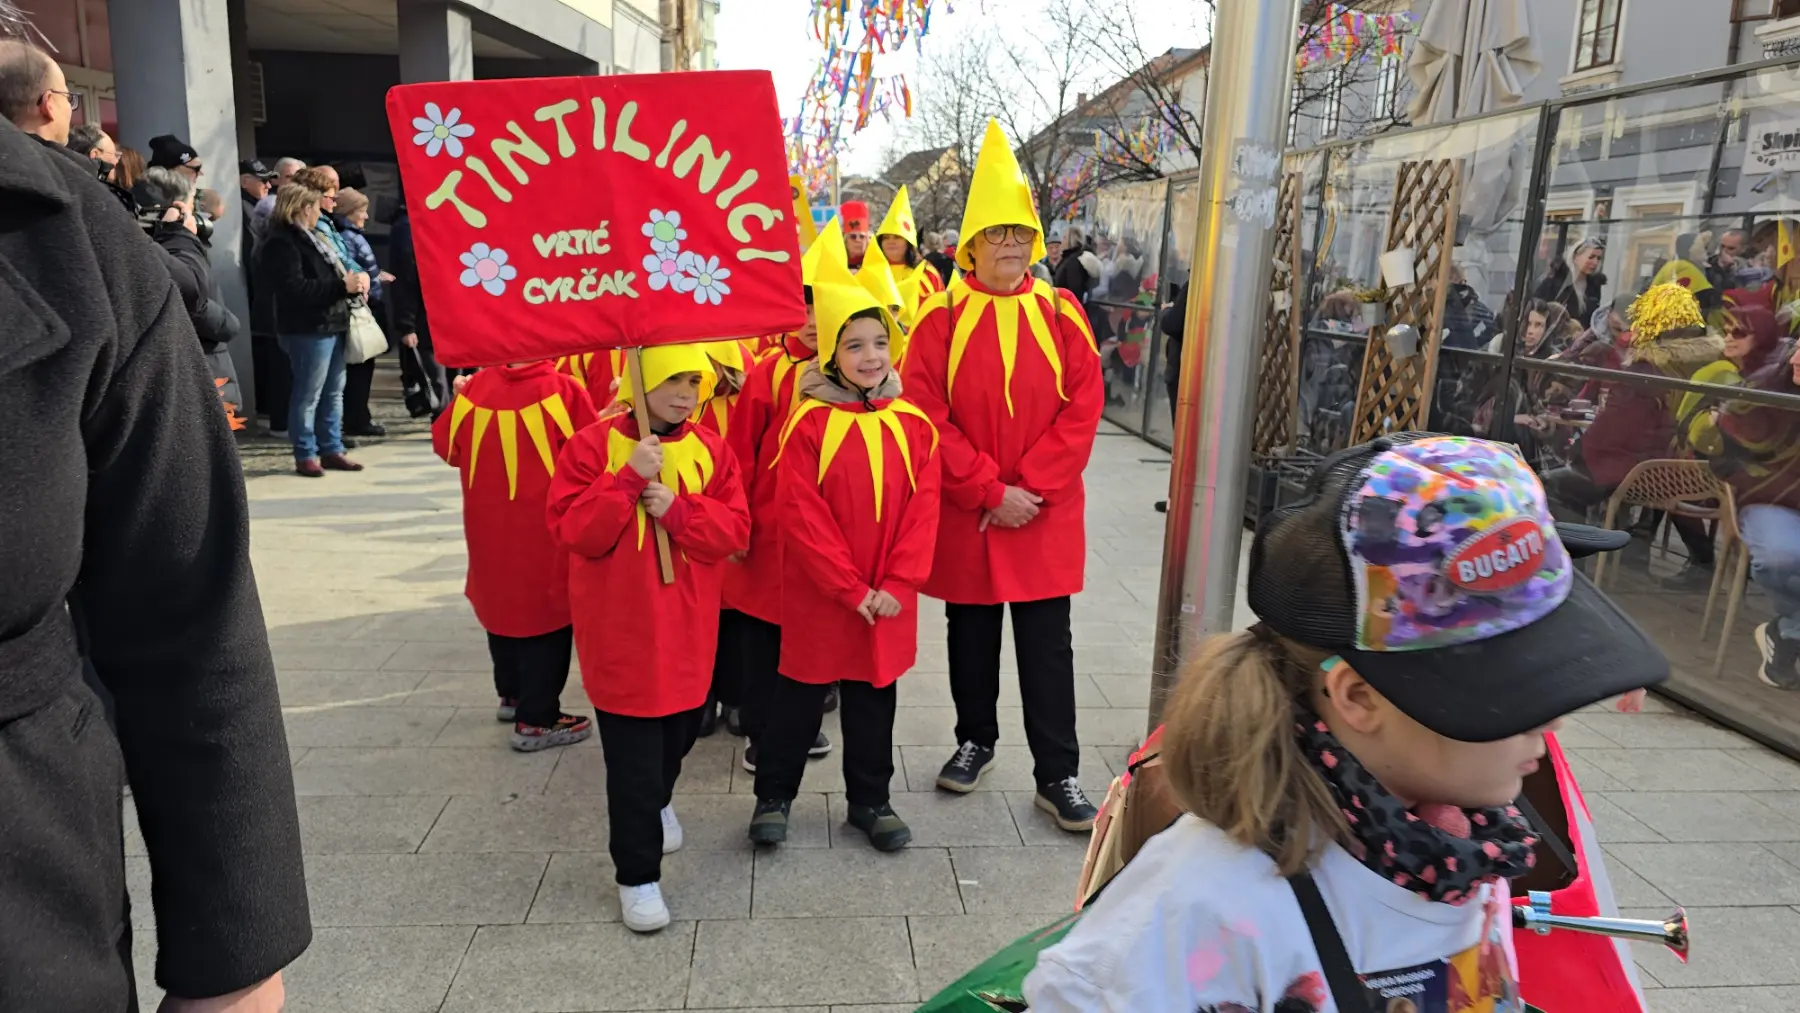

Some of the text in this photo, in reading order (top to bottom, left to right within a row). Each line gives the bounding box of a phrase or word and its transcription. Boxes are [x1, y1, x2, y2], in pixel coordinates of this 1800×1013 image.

[425, 96, 790, 263] TINTILINIĆI
[533, 220, 611, 258] VRTIĆ
[523, 268, 639, 305] CVRČAK
